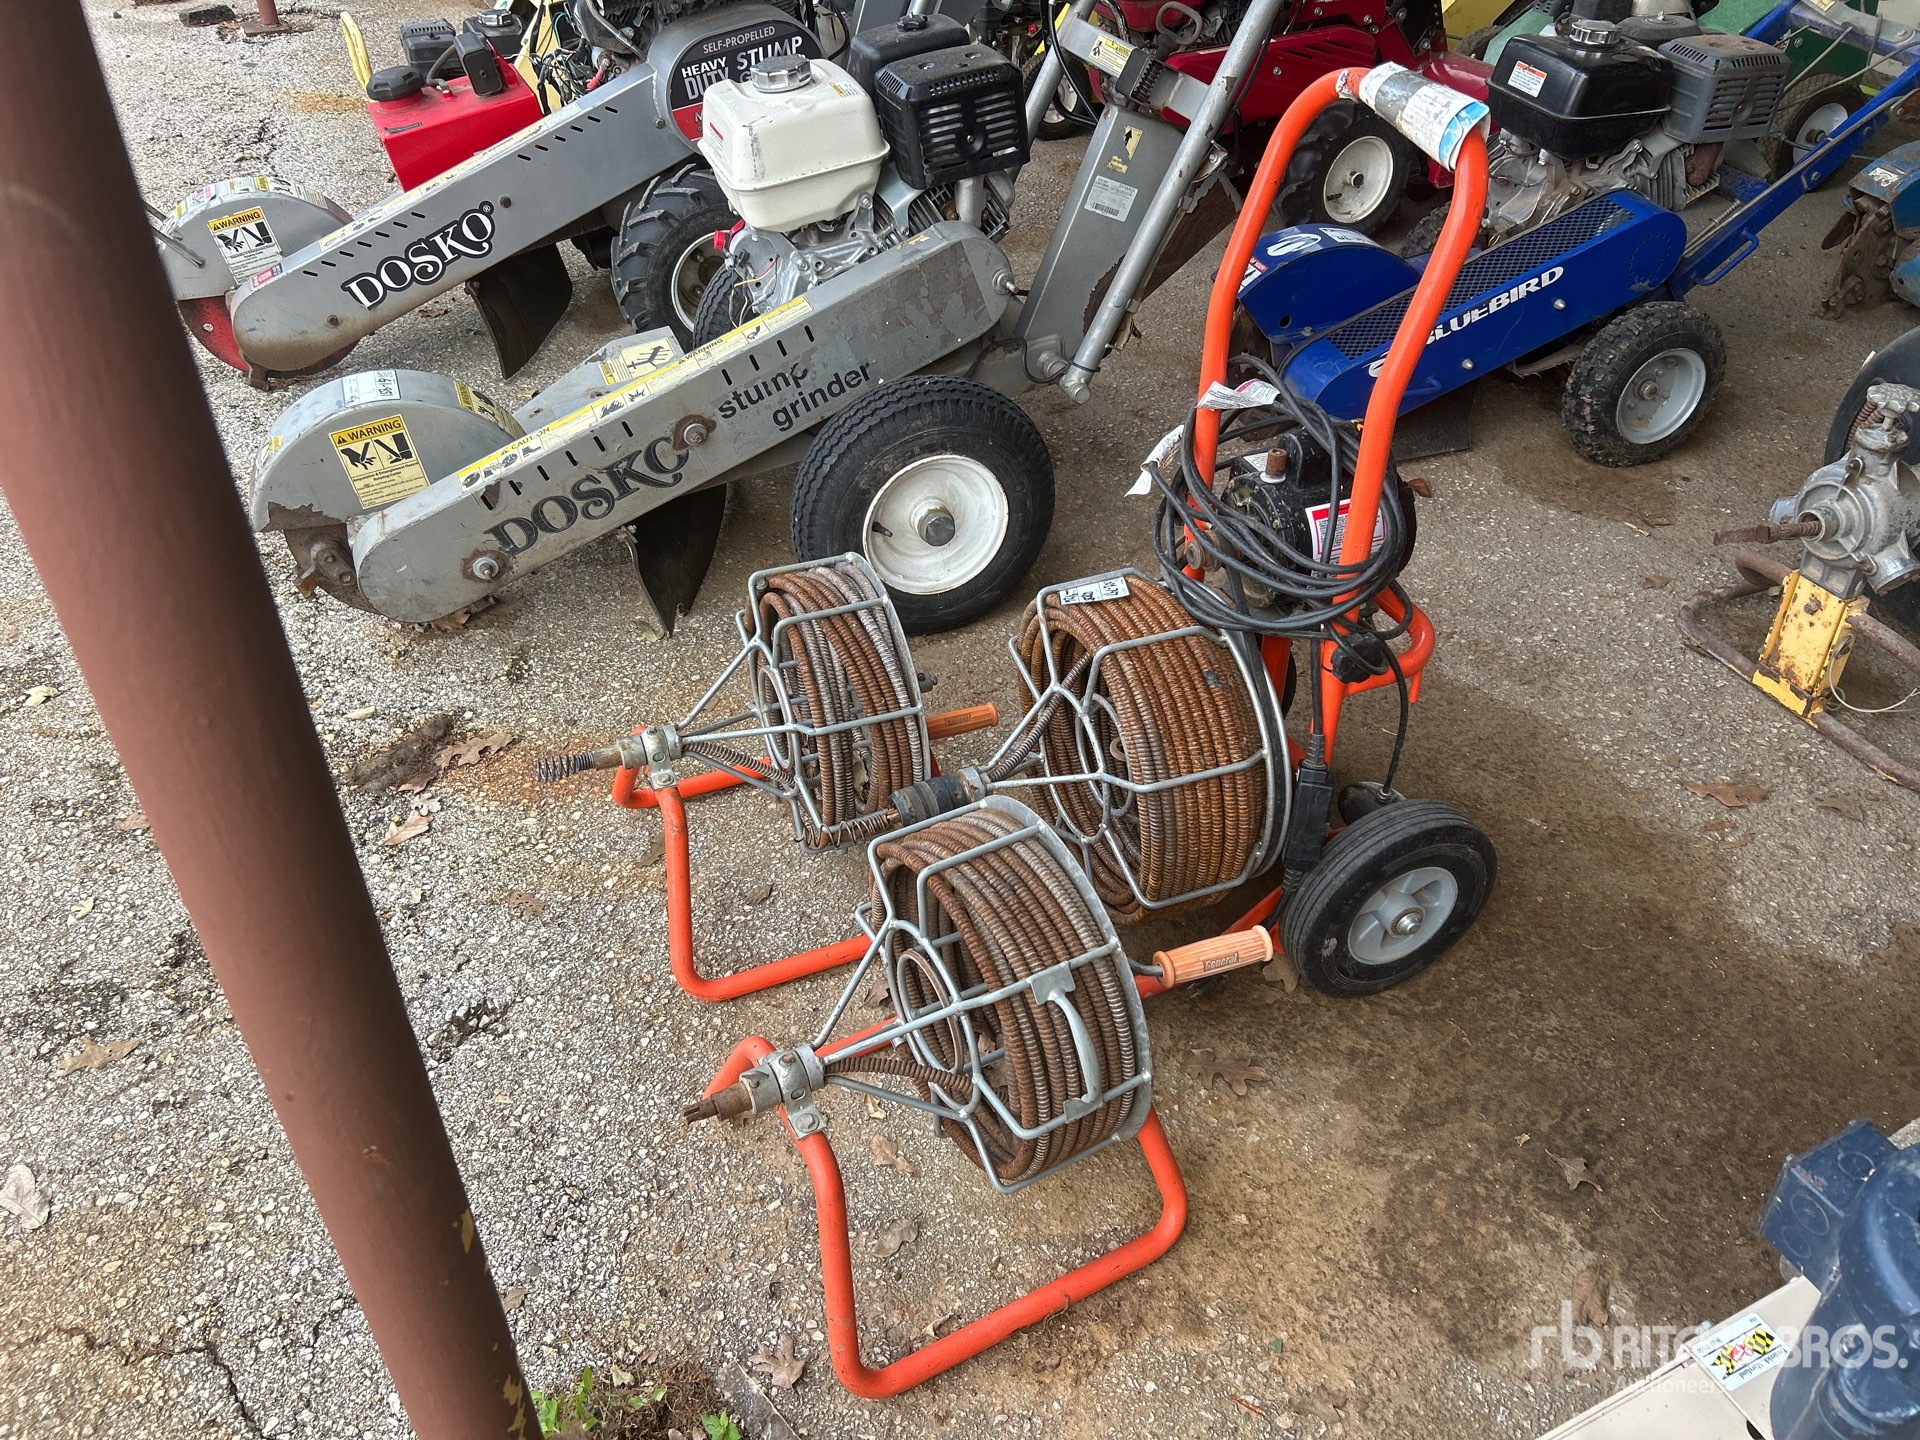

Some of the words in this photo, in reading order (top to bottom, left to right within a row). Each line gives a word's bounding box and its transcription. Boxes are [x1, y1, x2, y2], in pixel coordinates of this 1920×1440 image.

[703, 26, 776, 54] SELF-PROPELLED
[682, 57, 727, 78] HEAVY
[220, 211, 261, 229] WARNING
[772, 362, 870, 432] grinder
[348, 419, 401, 441] WARNING
